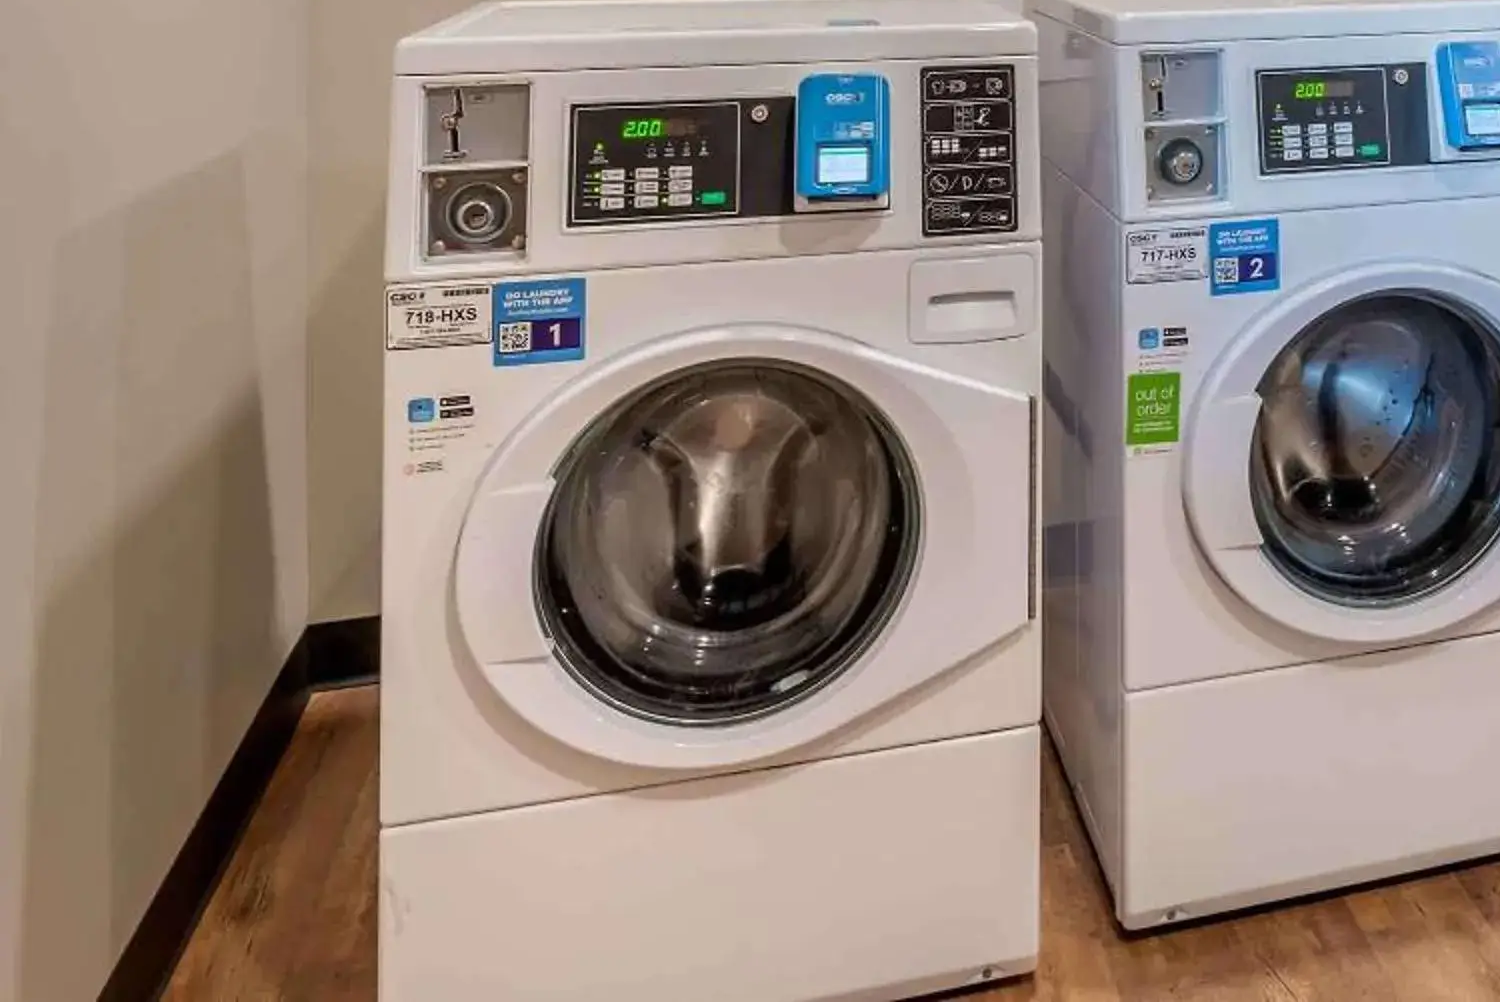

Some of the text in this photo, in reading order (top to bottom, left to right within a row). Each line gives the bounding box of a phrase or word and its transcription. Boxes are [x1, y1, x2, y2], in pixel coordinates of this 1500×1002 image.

[1141, 248, 1197, 263] 717-HXS
[1249, 258, 1264, 279] 2
[406, 307, 478, 325] 718-HXS
[549, 323, 562, 347] 1
[1135, 384, 1175, 401] out of
[1137, 401, 1172, 417] order
